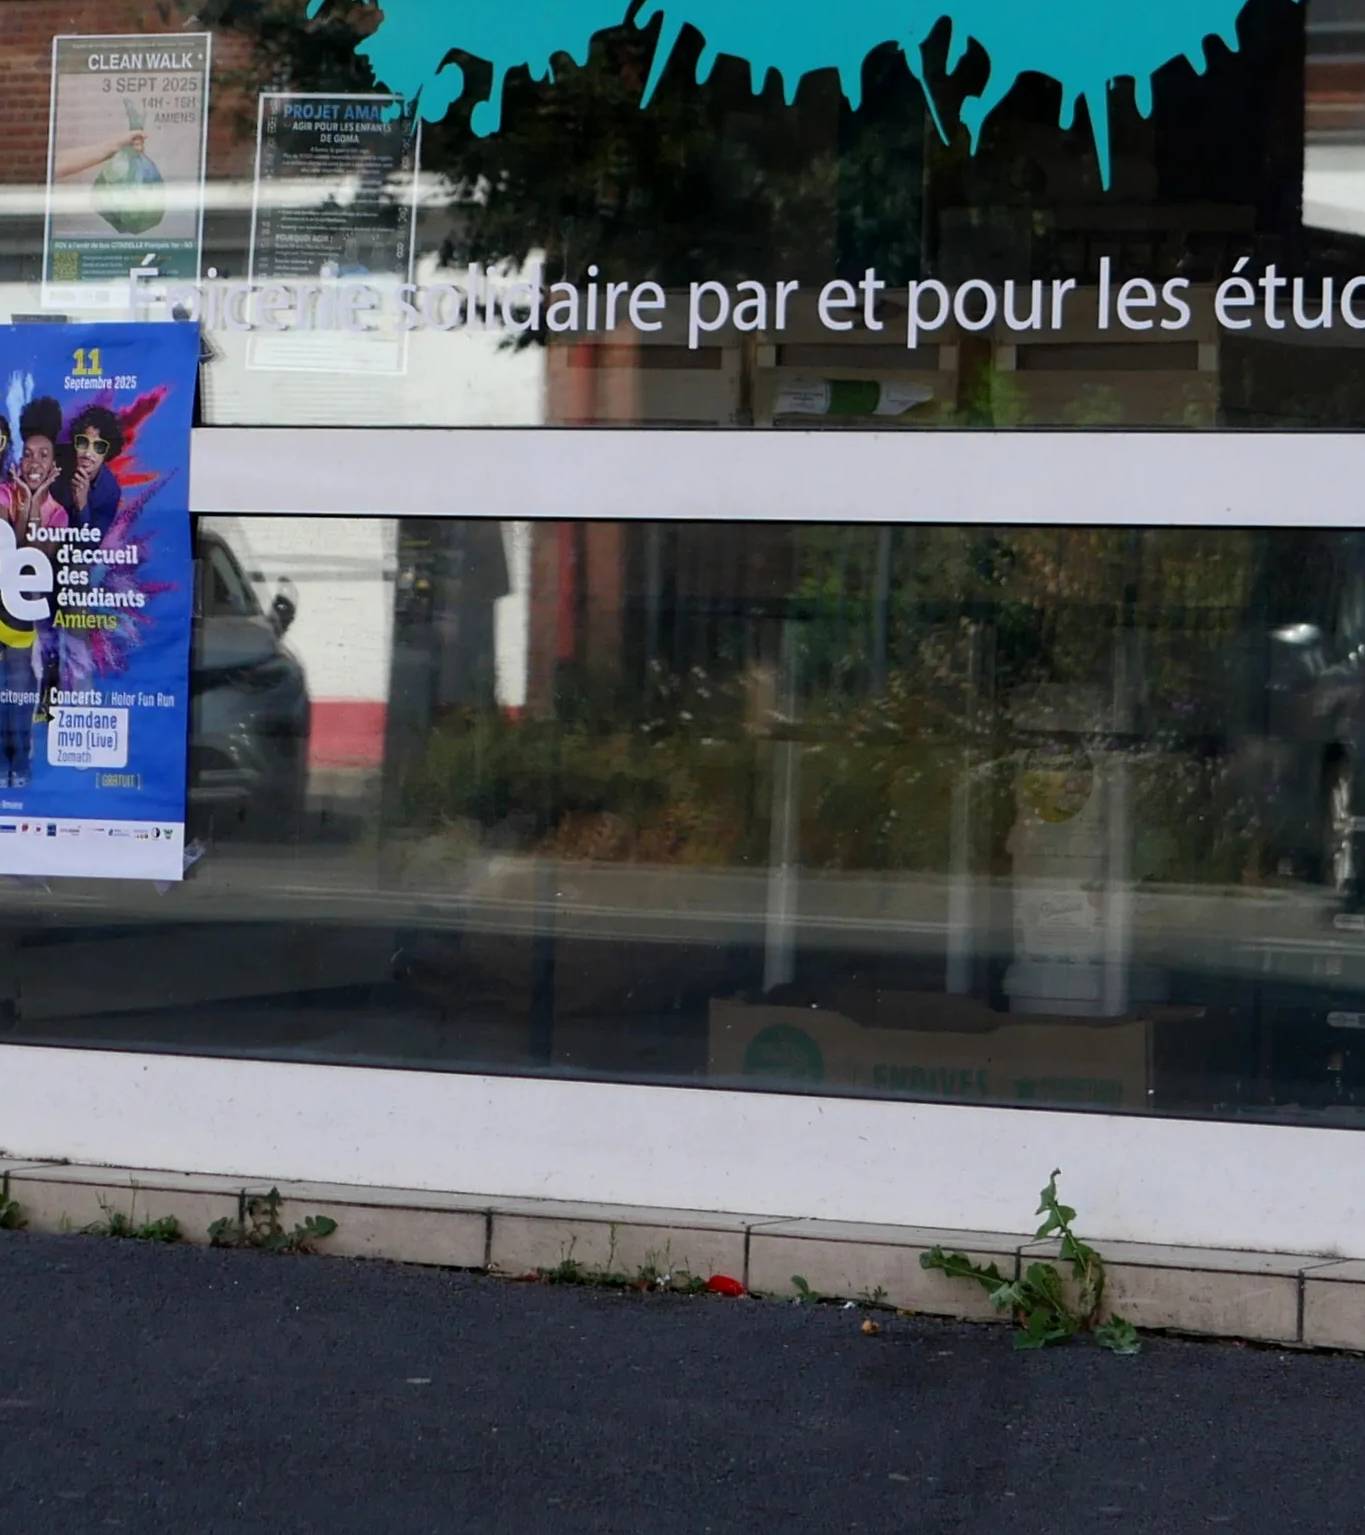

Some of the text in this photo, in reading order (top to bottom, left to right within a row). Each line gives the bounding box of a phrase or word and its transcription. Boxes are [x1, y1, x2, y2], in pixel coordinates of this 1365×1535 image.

[88, 52, 193, 70] CLEAN WALK
[102, 77, 198, 93] 3 SEPT 2025
[142, 98, 163, 109] 14H
[283, 104, 340, 119] PROJET
[154, 113, 196, 124] AMIENS
[292, 121, 392, 133] AGIR POUR LES ENFANTS
[320, 133, 360, 143] DE GOMA
[275, 234, 329, 243] POURQUOI AGIR
[129, 253, 377, 333] Épicerie
[398, 262, 667, 333] solidaire
[687, 277, 799, 349] par
[817, 267, 884, 332] et
[906, 276, 1076, 349] pour
[1096, 256, 1192, 331] les
[72, 348, 103, 376] 11
[64, 376, 137, 391] Septembre 2025
[26, 523, 101, 543] Journée
[57, 545, 139, 565] d'accueil
[57, 566, 89, 585] des
[57, 588, 146, 608] étudiants
[52, 610, 118, 630] Amiens
[0, 688, 40, 707] citoyens
[50, 687, 103, 706] Concerts
[138, 692, 155, 707] Fun
[157, 693, 176, 707] Run
[58, 711, 117, 729] Zamdane
[57, 732, 83, 748] MYD
[57, 750, 92, 763] Zomath
